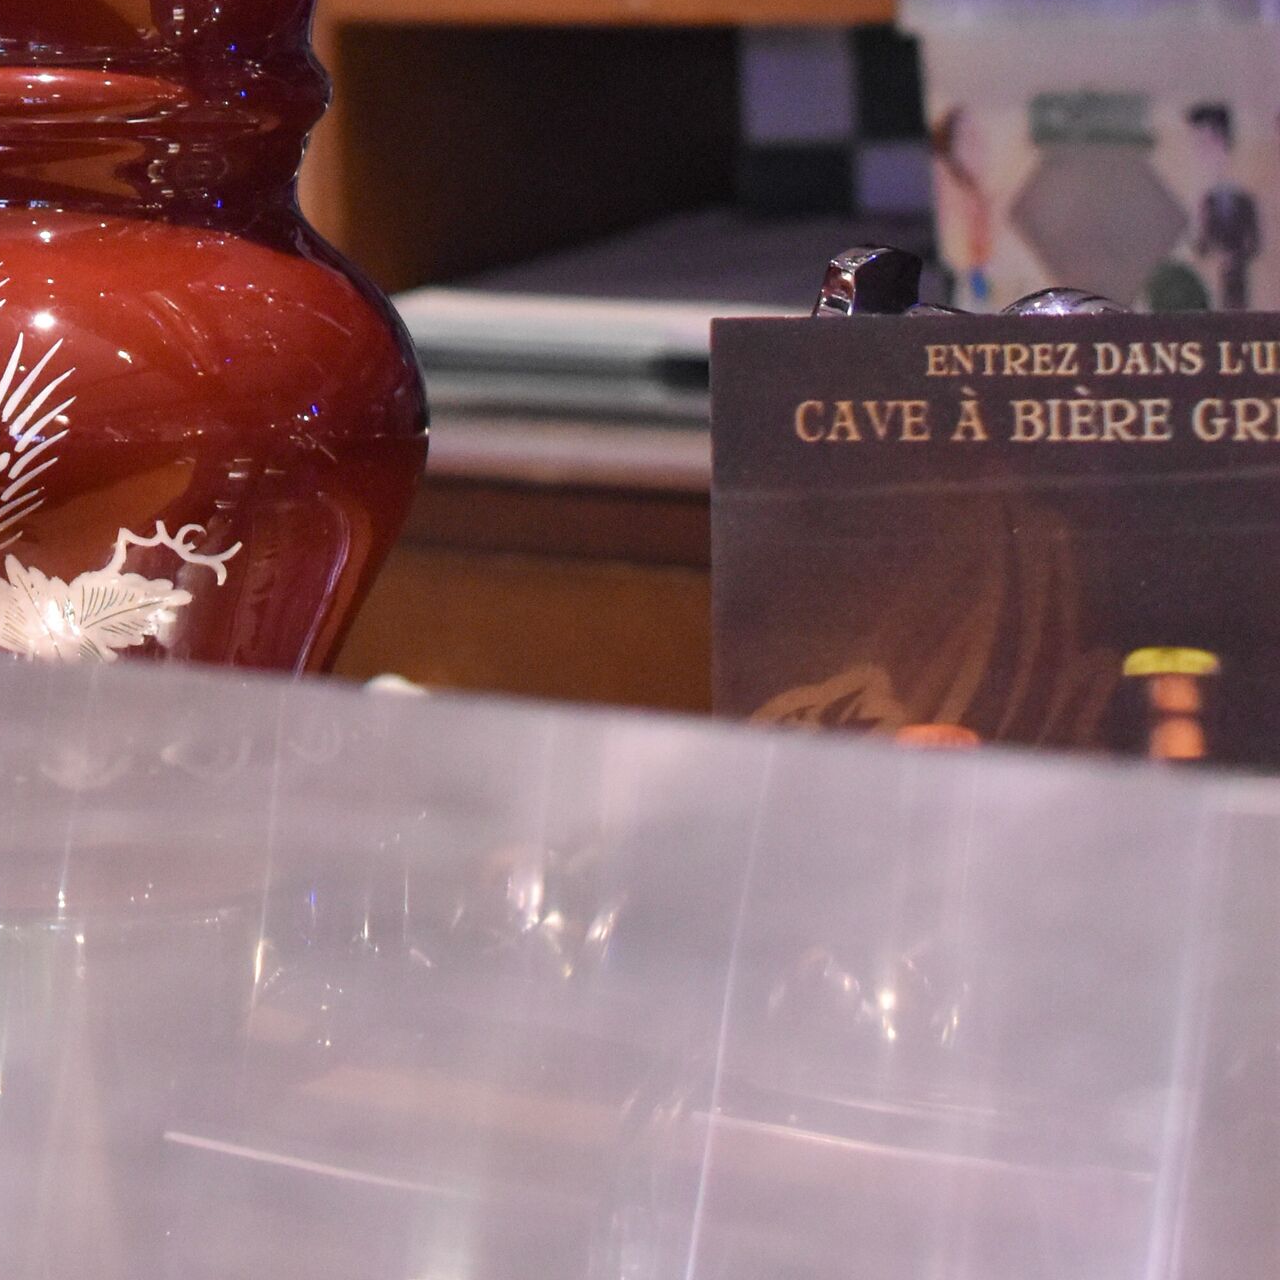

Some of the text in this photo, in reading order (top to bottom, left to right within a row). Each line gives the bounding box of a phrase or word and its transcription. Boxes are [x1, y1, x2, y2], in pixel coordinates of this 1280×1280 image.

[925, 343, 1079, 377] ENTREZ
[1093, 342, 1204, 376] DANS
[794, 398, 932, 442] CAVE
[950, 386, 988, 441] À
[1010, 385, 1173, 442] BIÈRE
